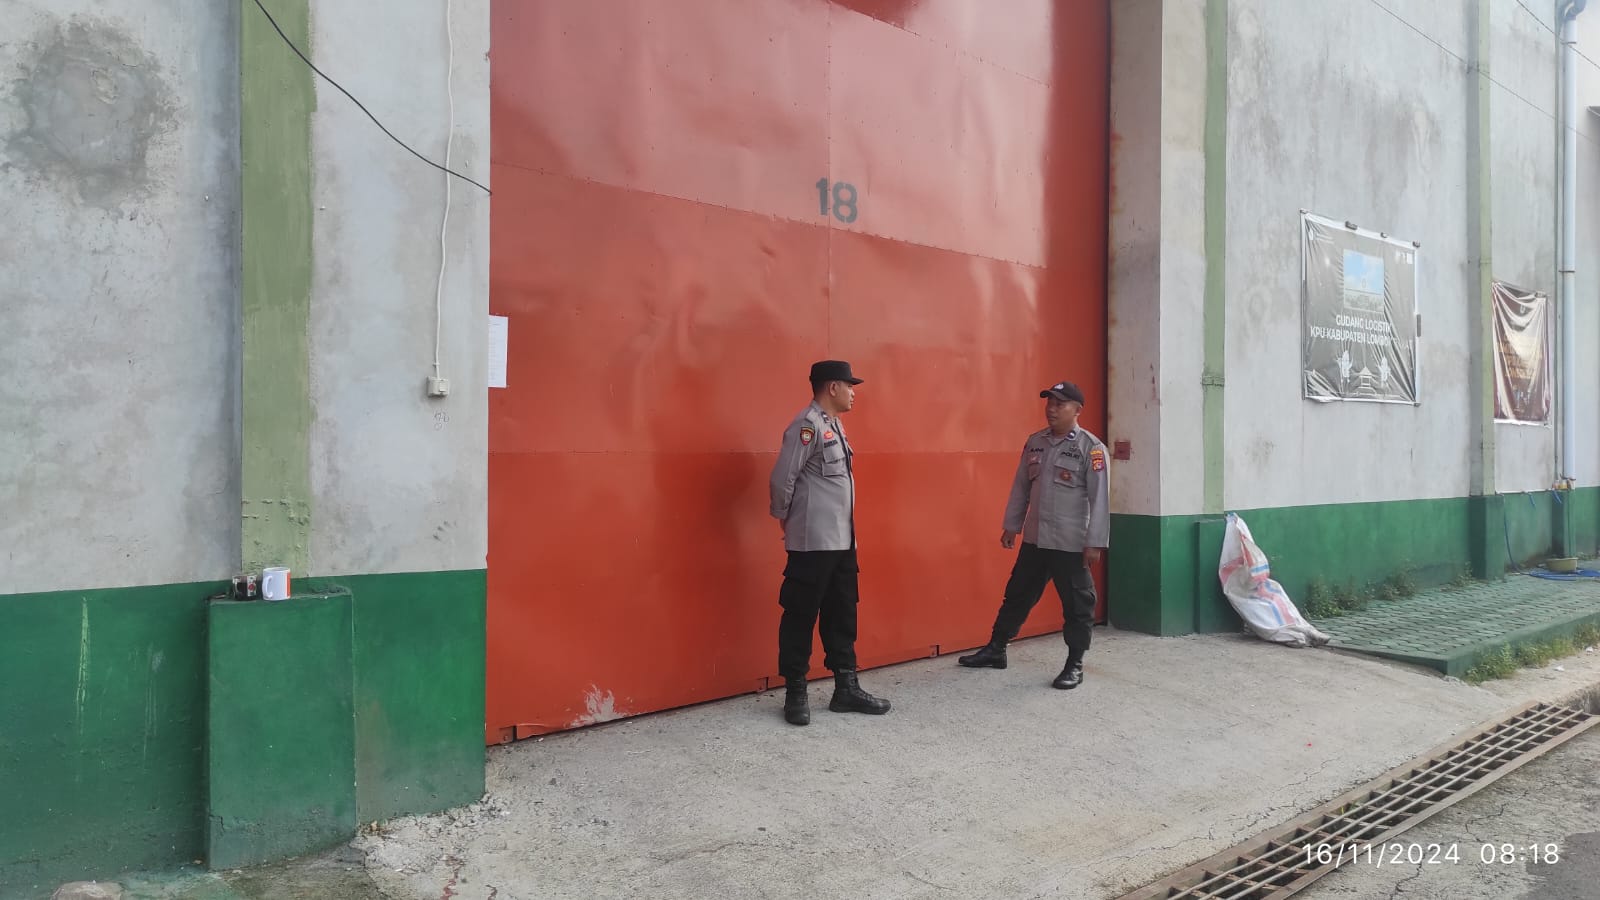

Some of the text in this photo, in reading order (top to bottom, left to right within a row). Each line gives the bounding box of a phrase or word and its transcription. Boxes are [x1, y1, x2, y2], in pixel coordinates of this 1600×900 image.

[816, 177, 858, 224] 18
[1335, 314, 1364, 329] GUDANG
[1310, 325, 1325, 338] KPU
[1326, 327, 1366, 344] KABUPATEN
